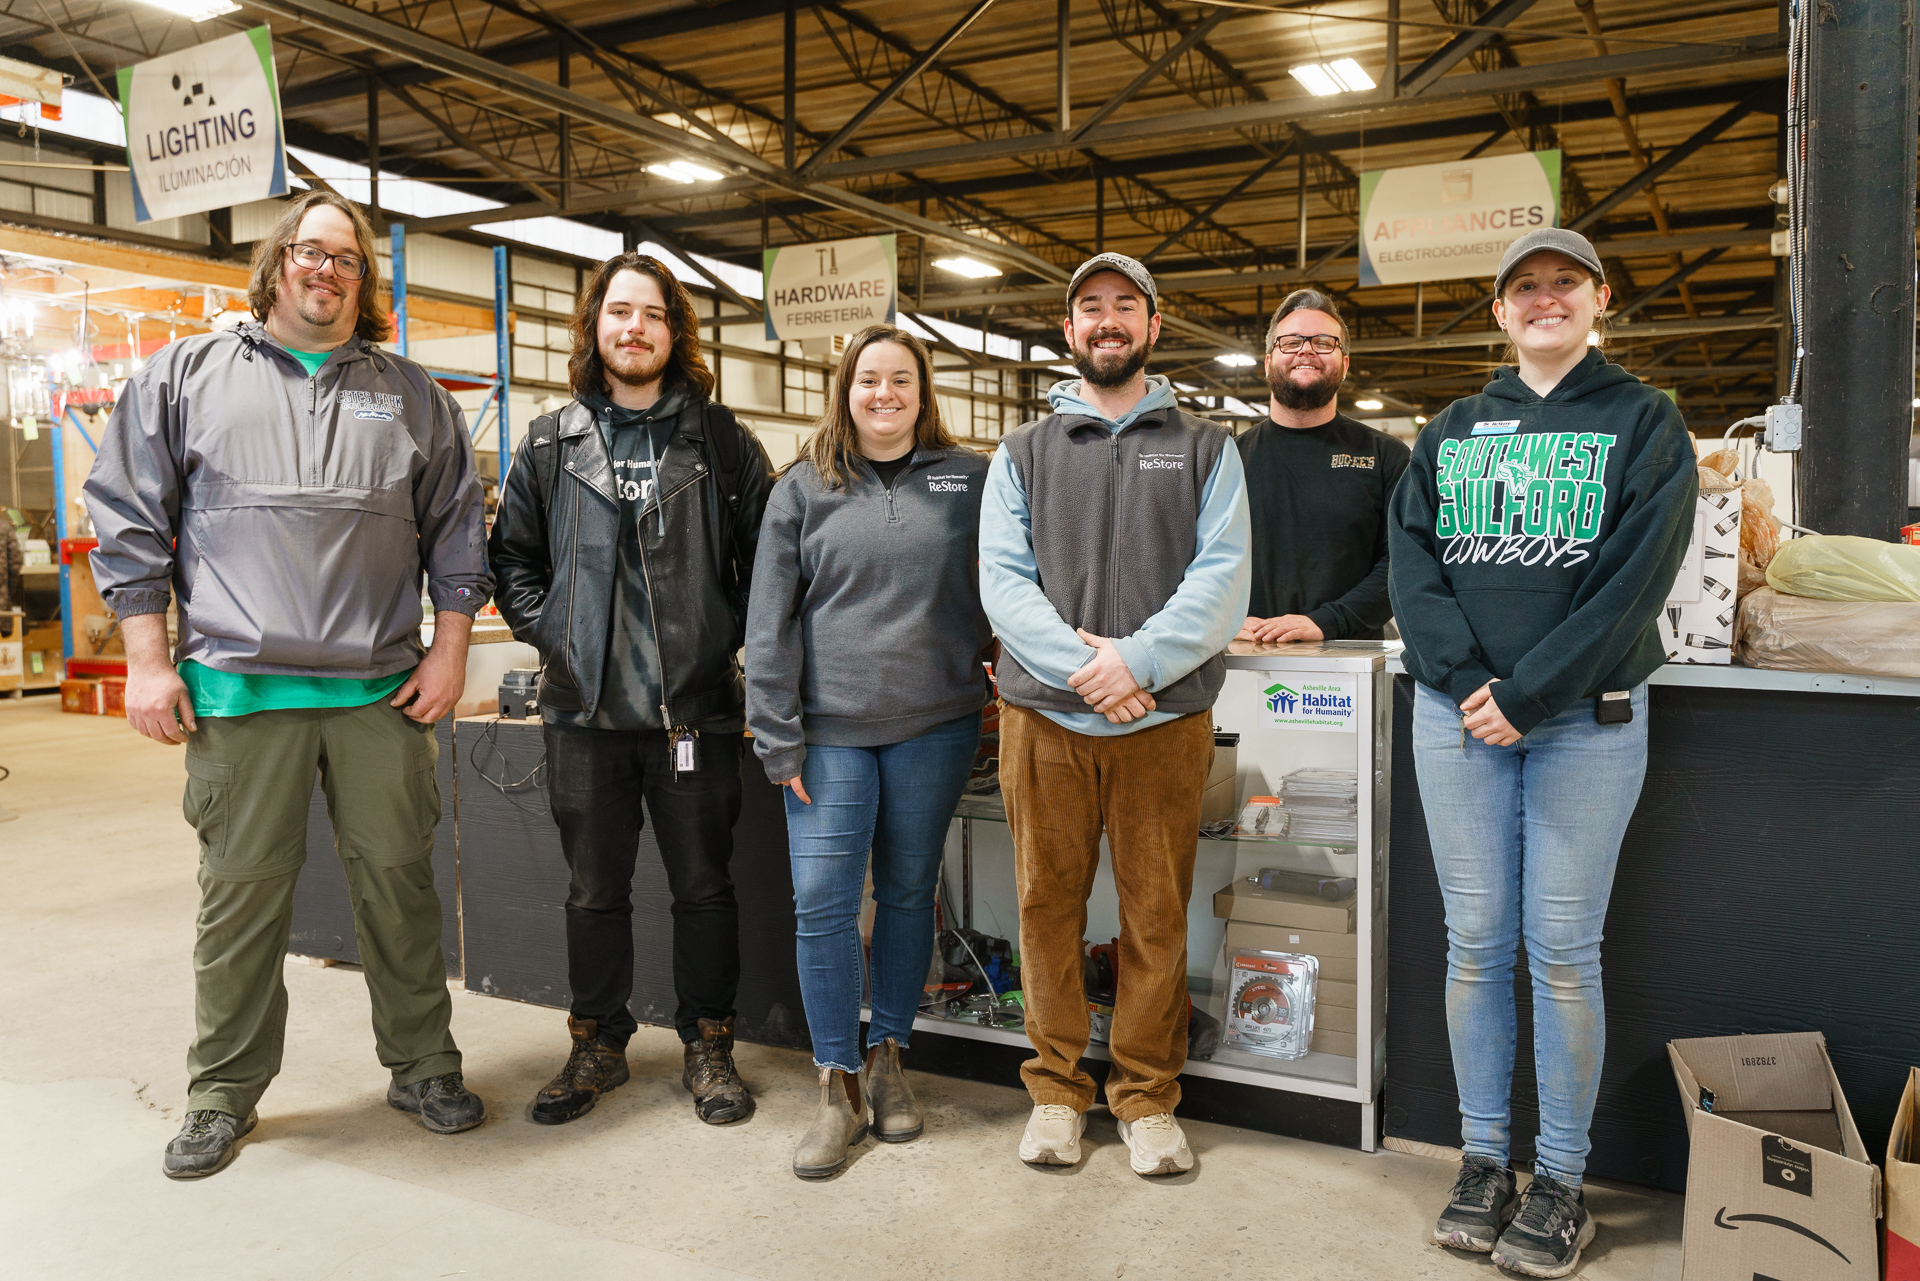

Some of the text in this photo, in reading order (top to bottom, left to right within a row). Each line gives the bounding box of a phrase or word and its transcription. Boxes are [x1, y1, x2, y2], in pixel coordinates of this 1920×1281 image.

[146, 108, 257, 162] LIGHTING
[158, 154, 252, 193] ILUMINACIÓN
[1373, 205, 1544, 242] APPLIANCES
[774, 279, 886, 307] HARDWARE
[786, 304, 874, 327] FERRETERÍA
[336, 390, 404, 409] ESTES PARK
[613, 460, 625, 468] for
[1139, 458, 1184, 470] ReStore
[1437, 432, 1617, 485] SOUTHWEST
[928, 480, 969, 492] ReStore
[1436, 478, 1607, 542] GUILFORD
[1442, 534, 1590, 568] COWBOYS
[1302, 693, 1352, 708] Habitat
[1302, 707, 1313, 715] for
[1274, 718, 1343, 727] www.ashevillehabitat.org
[1741, 1056, 1777, 1066] 3782891
